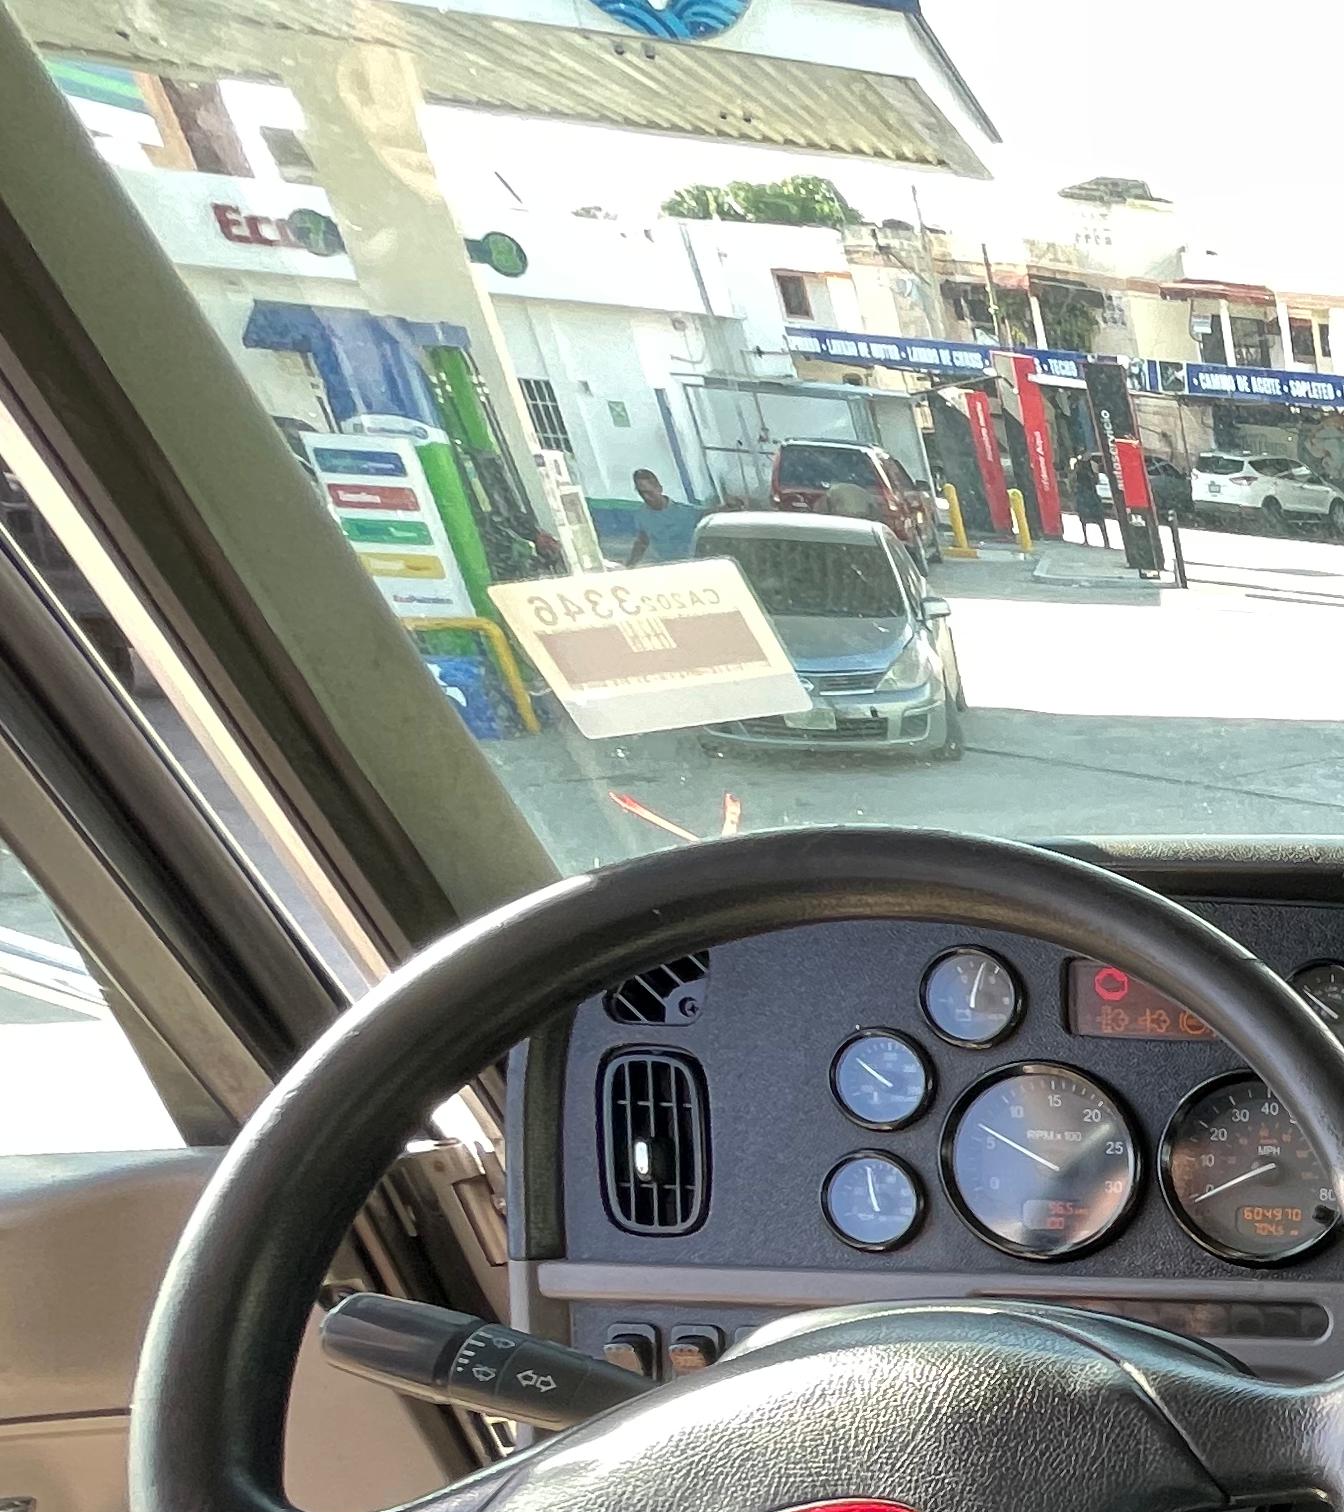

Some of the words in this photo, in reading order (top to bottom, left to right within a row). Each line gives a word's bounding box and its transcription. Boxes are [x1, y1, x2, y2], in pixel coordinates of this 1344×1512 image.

[1251, 377, 1283, 395] ACEITE
[1047, 1094, 1063, 1108] 15
[1010, 1105, 1025, 1119] 10
[1082, 1108, 1102, 1123] 20
[1231, 1108, 1250, 1123] 30
[1260, 1102, 1280, 1116] 40
[1026, 1129, 1055, 1142] RPM
[1064, 1130, 1082, 1142] 100
[1209, 1127, 1228, 1142] 20
[985, 1137, 997, 1151] 5
[1105, 1141, 1124, 1155] 25
[1257, 1145, 1281, 1156] MPH
[1201, 1154, 1216, 1168] 10
[989, 1176, 1000, 1190] 0
[1104, 1180, 1123, 1194] 30
